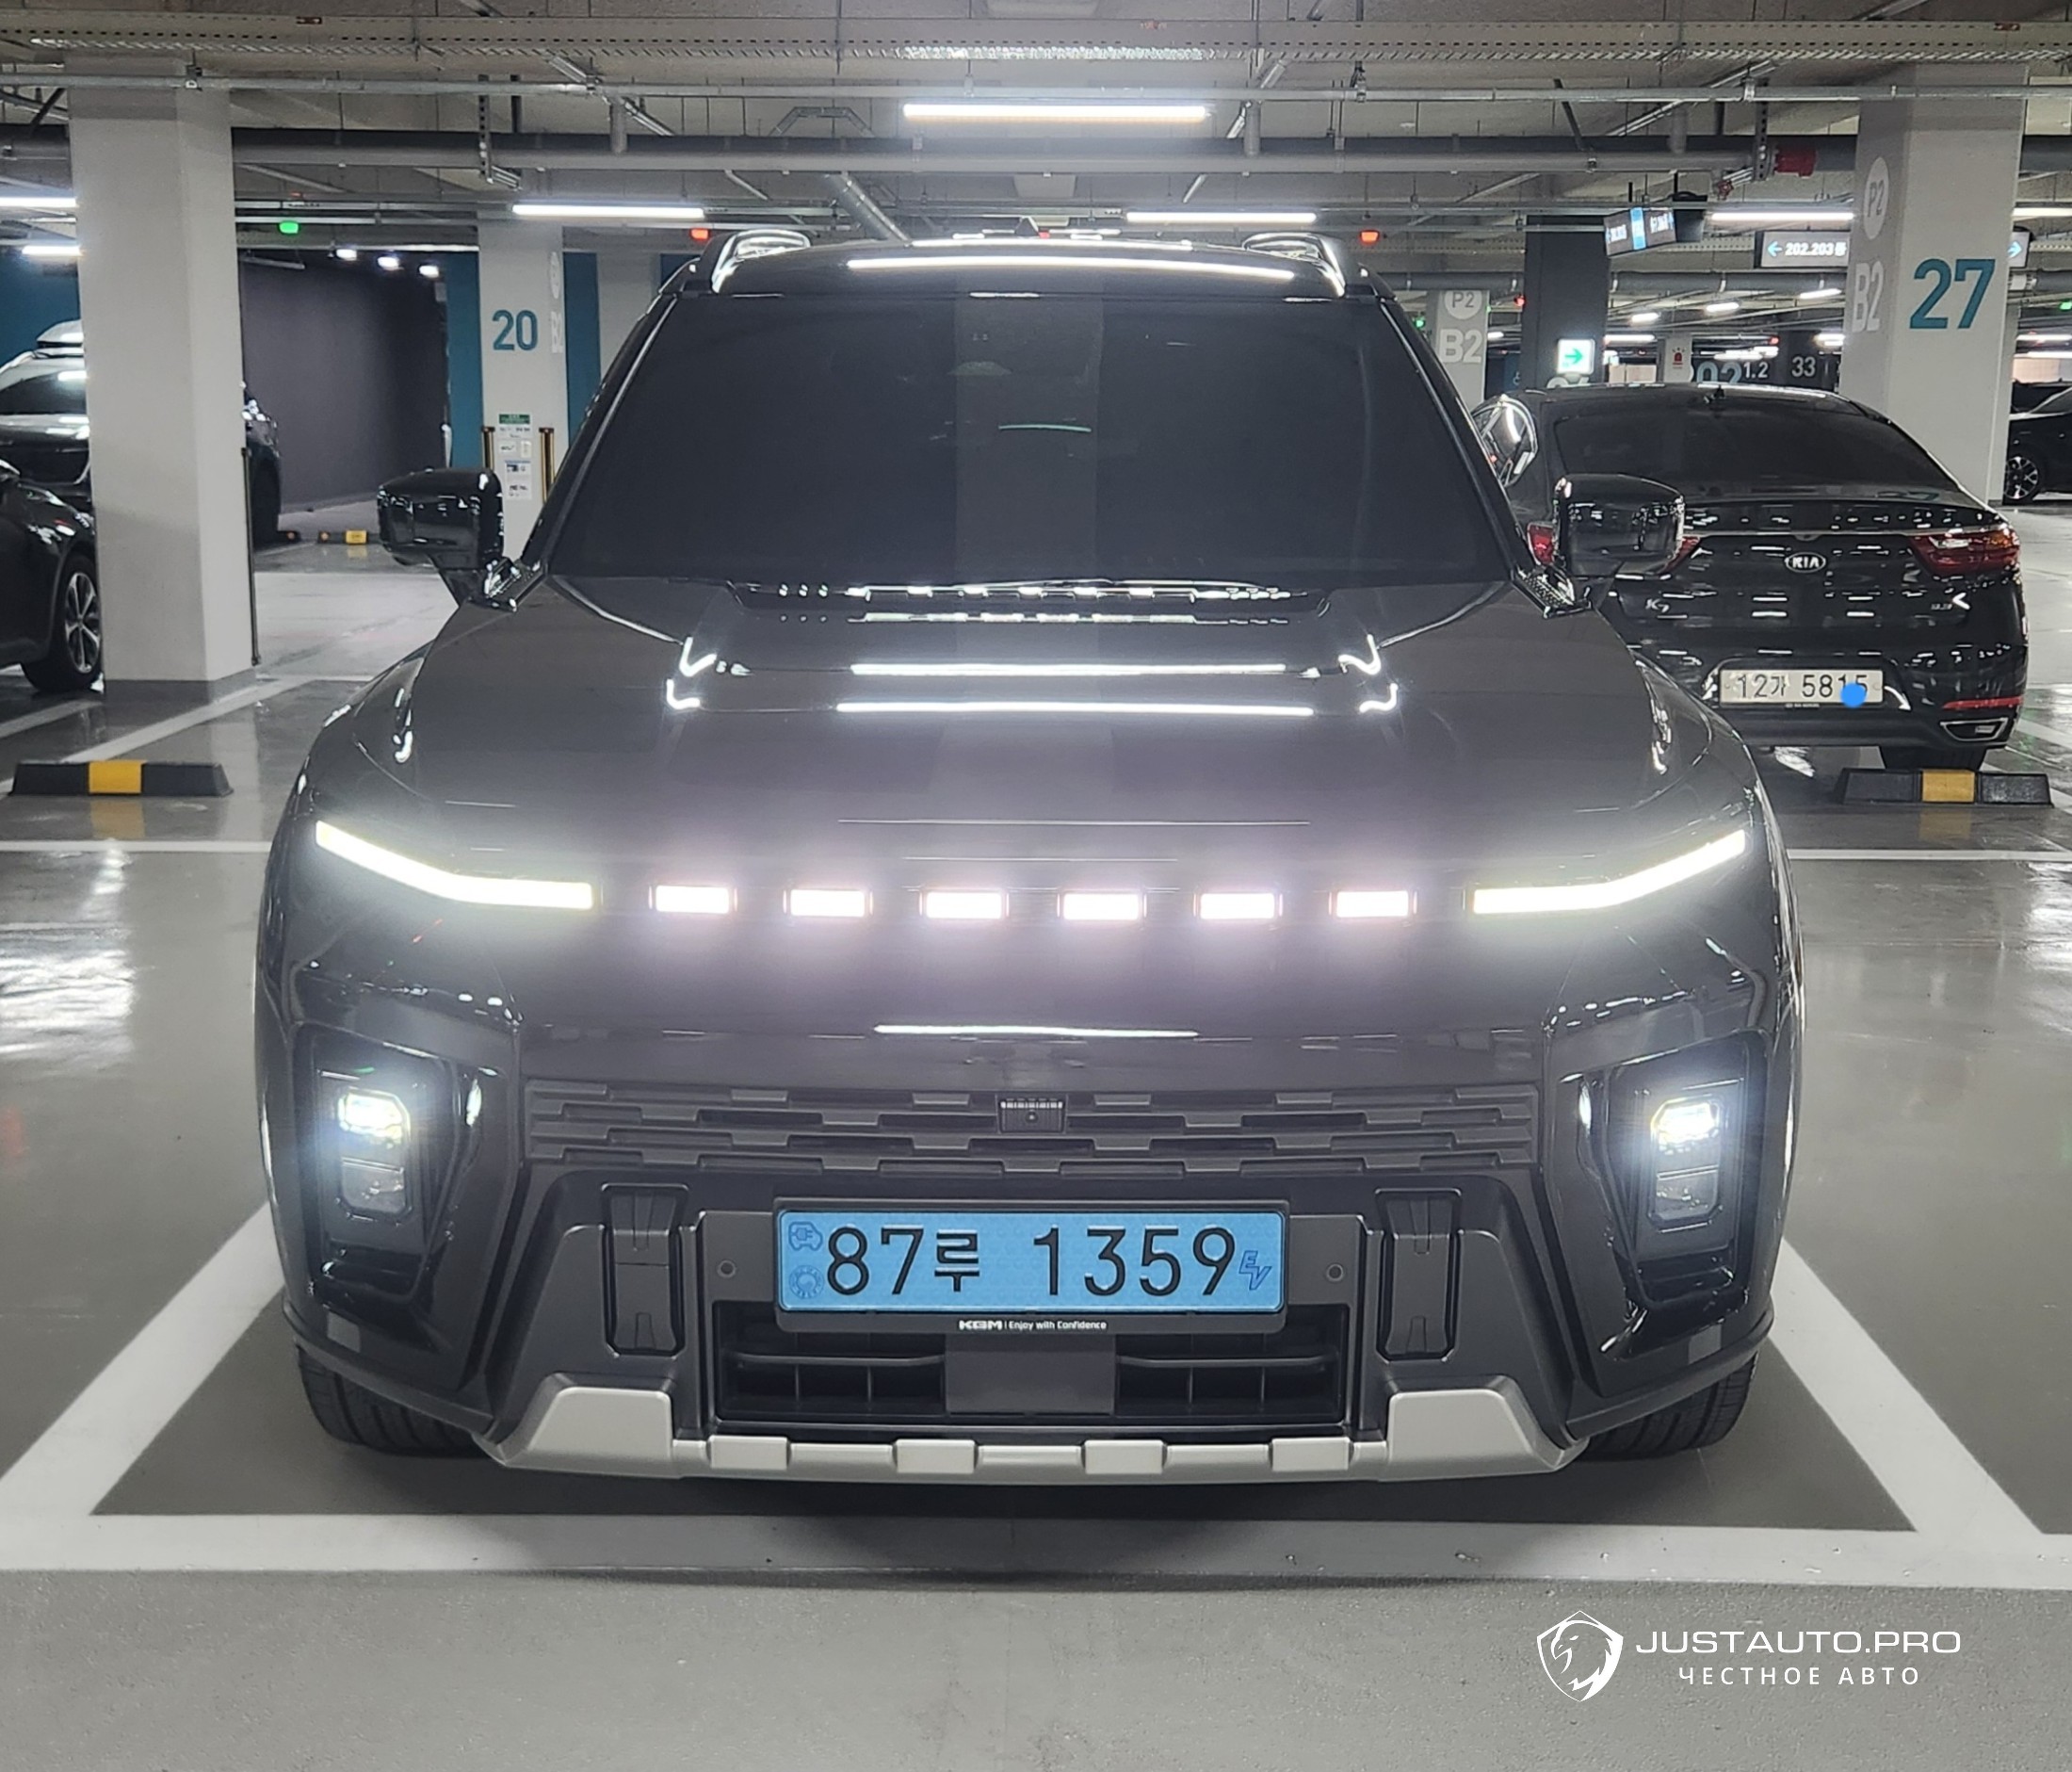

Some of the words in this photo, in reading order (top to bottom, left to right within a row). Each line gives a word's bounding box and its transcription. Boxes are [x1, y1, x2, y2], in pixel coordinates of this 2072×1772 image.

[1869, 180, 1885, 218] P2
[1452, 290, 1475, 308] P2
[1853, 261, 1884, 333] B2
[1909, 258, 1996, 329] 27
[493, 309, 538, 350] 20
[1440, 329, 1483, 364] B2
[1791, 356, 1816, 377] 33
[1792, 557, 1819, 568] KIA
[827, 1225, 980, 1295] 87루
[1033, 1225, 1236, 1296] 1359
[1238, 1249, 1272, 1291] EV
[959, 1320, 1003, 1330] KGM
[1009, 1321, 1033, 1330] Enjoy
[1036, 1321, 1055, 1329] with
[1057, 1321, 1107, 1329] Confidence
